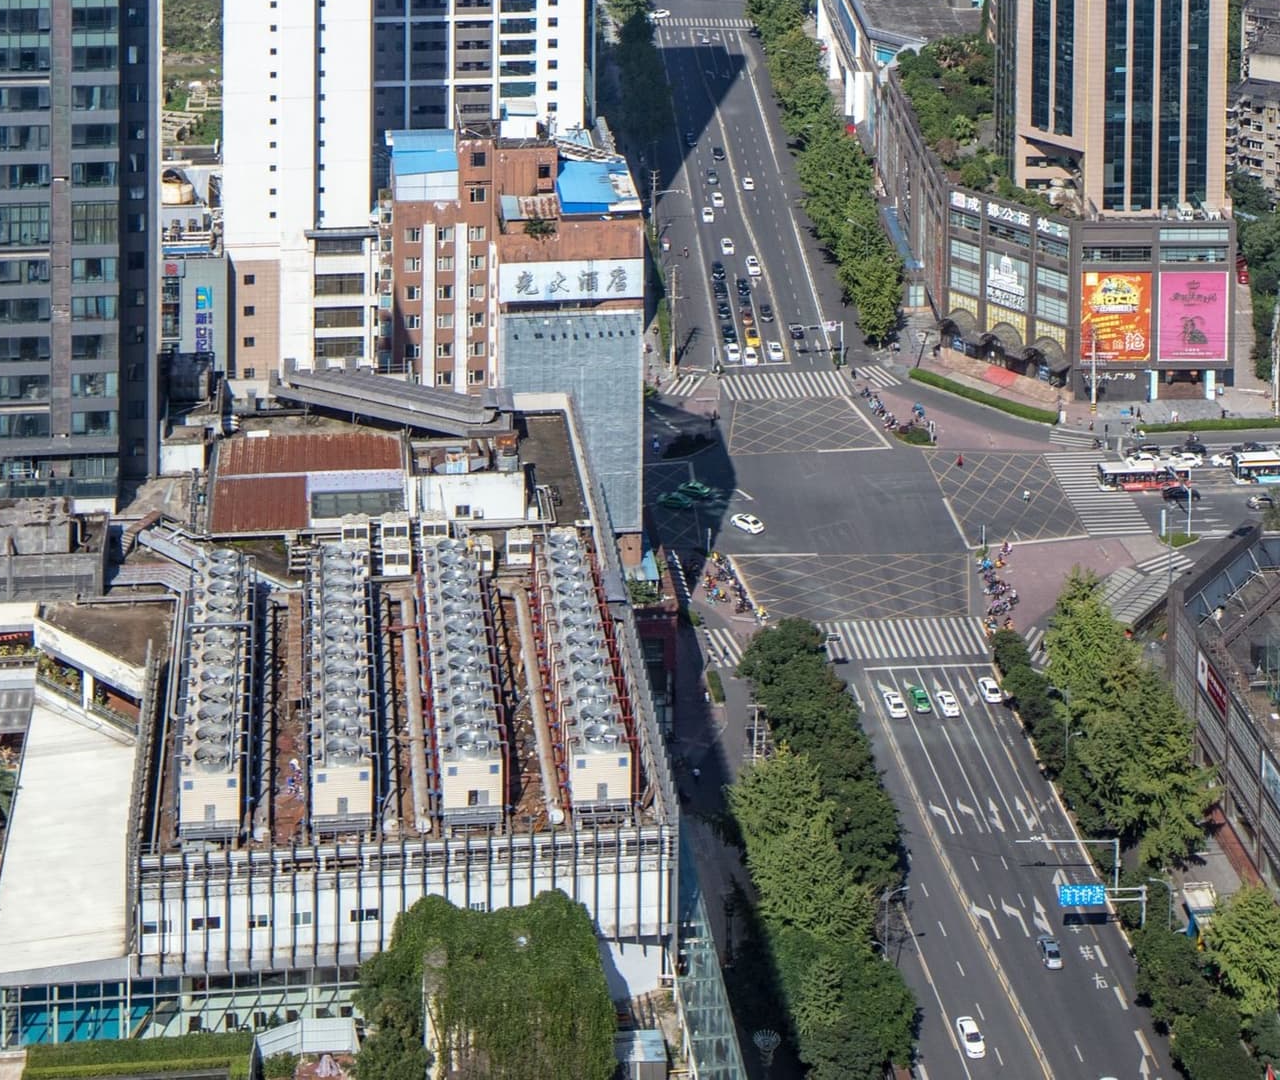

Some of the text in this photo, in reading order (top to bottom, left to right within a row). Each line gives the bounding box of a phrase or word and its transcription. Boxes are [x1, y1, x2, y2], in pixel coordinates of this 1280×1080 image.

[967, 197, 1050, 233] 成都公证处
